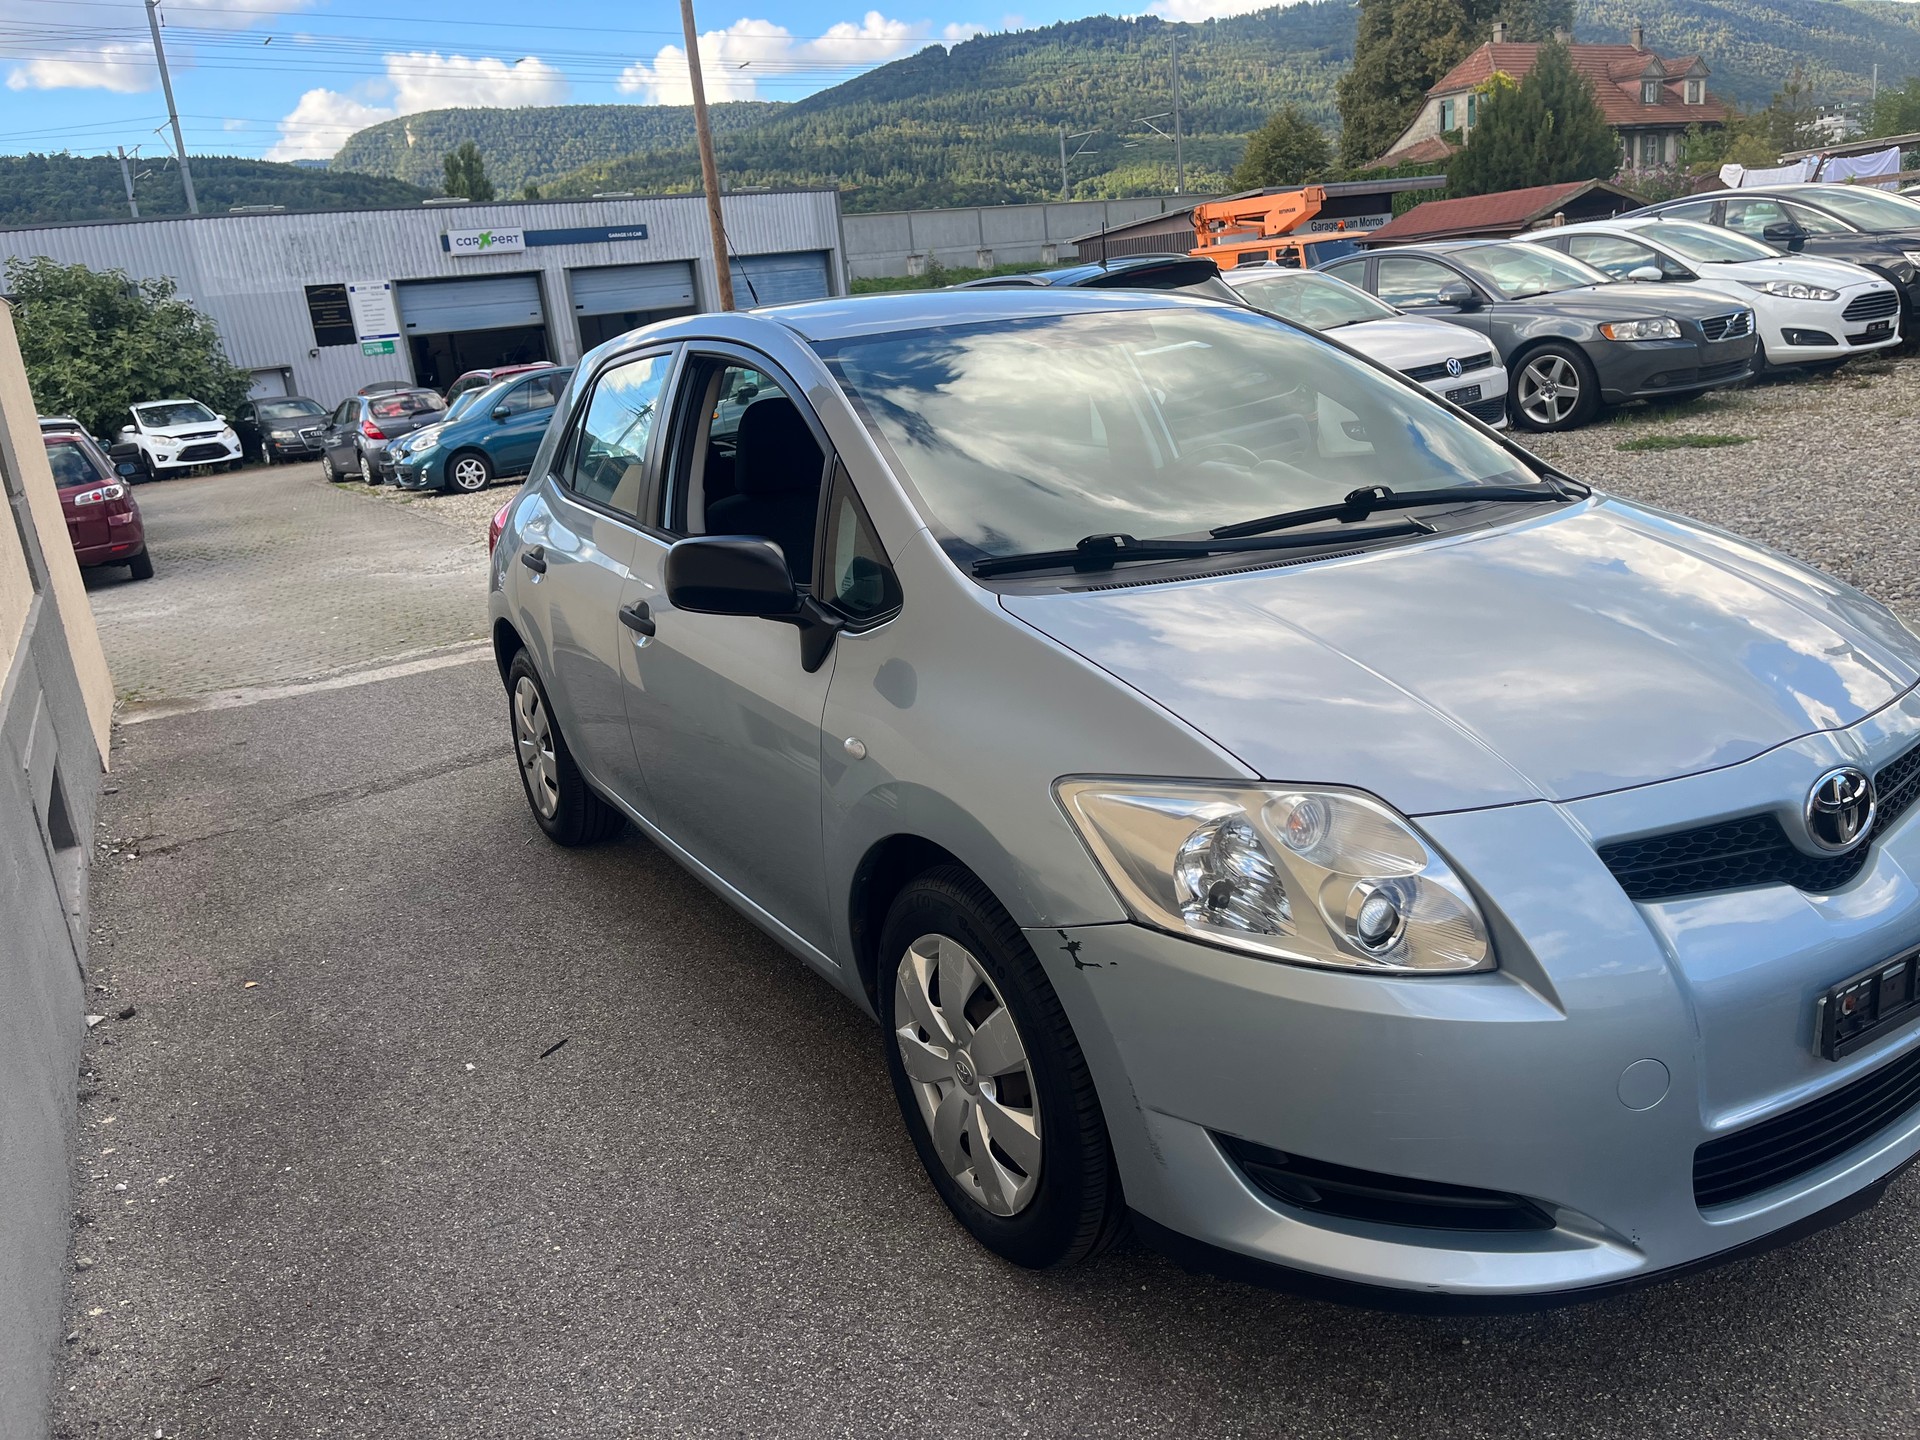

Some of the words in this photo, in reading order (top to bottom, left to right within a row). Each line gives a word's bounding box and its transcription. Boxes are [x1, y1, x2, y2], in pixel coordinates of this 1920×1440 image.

[1311, 221, 1338, 232] Garage
[1343, 219, 1358, 229] uan
[1359, 217, 1384, 227] Morros
